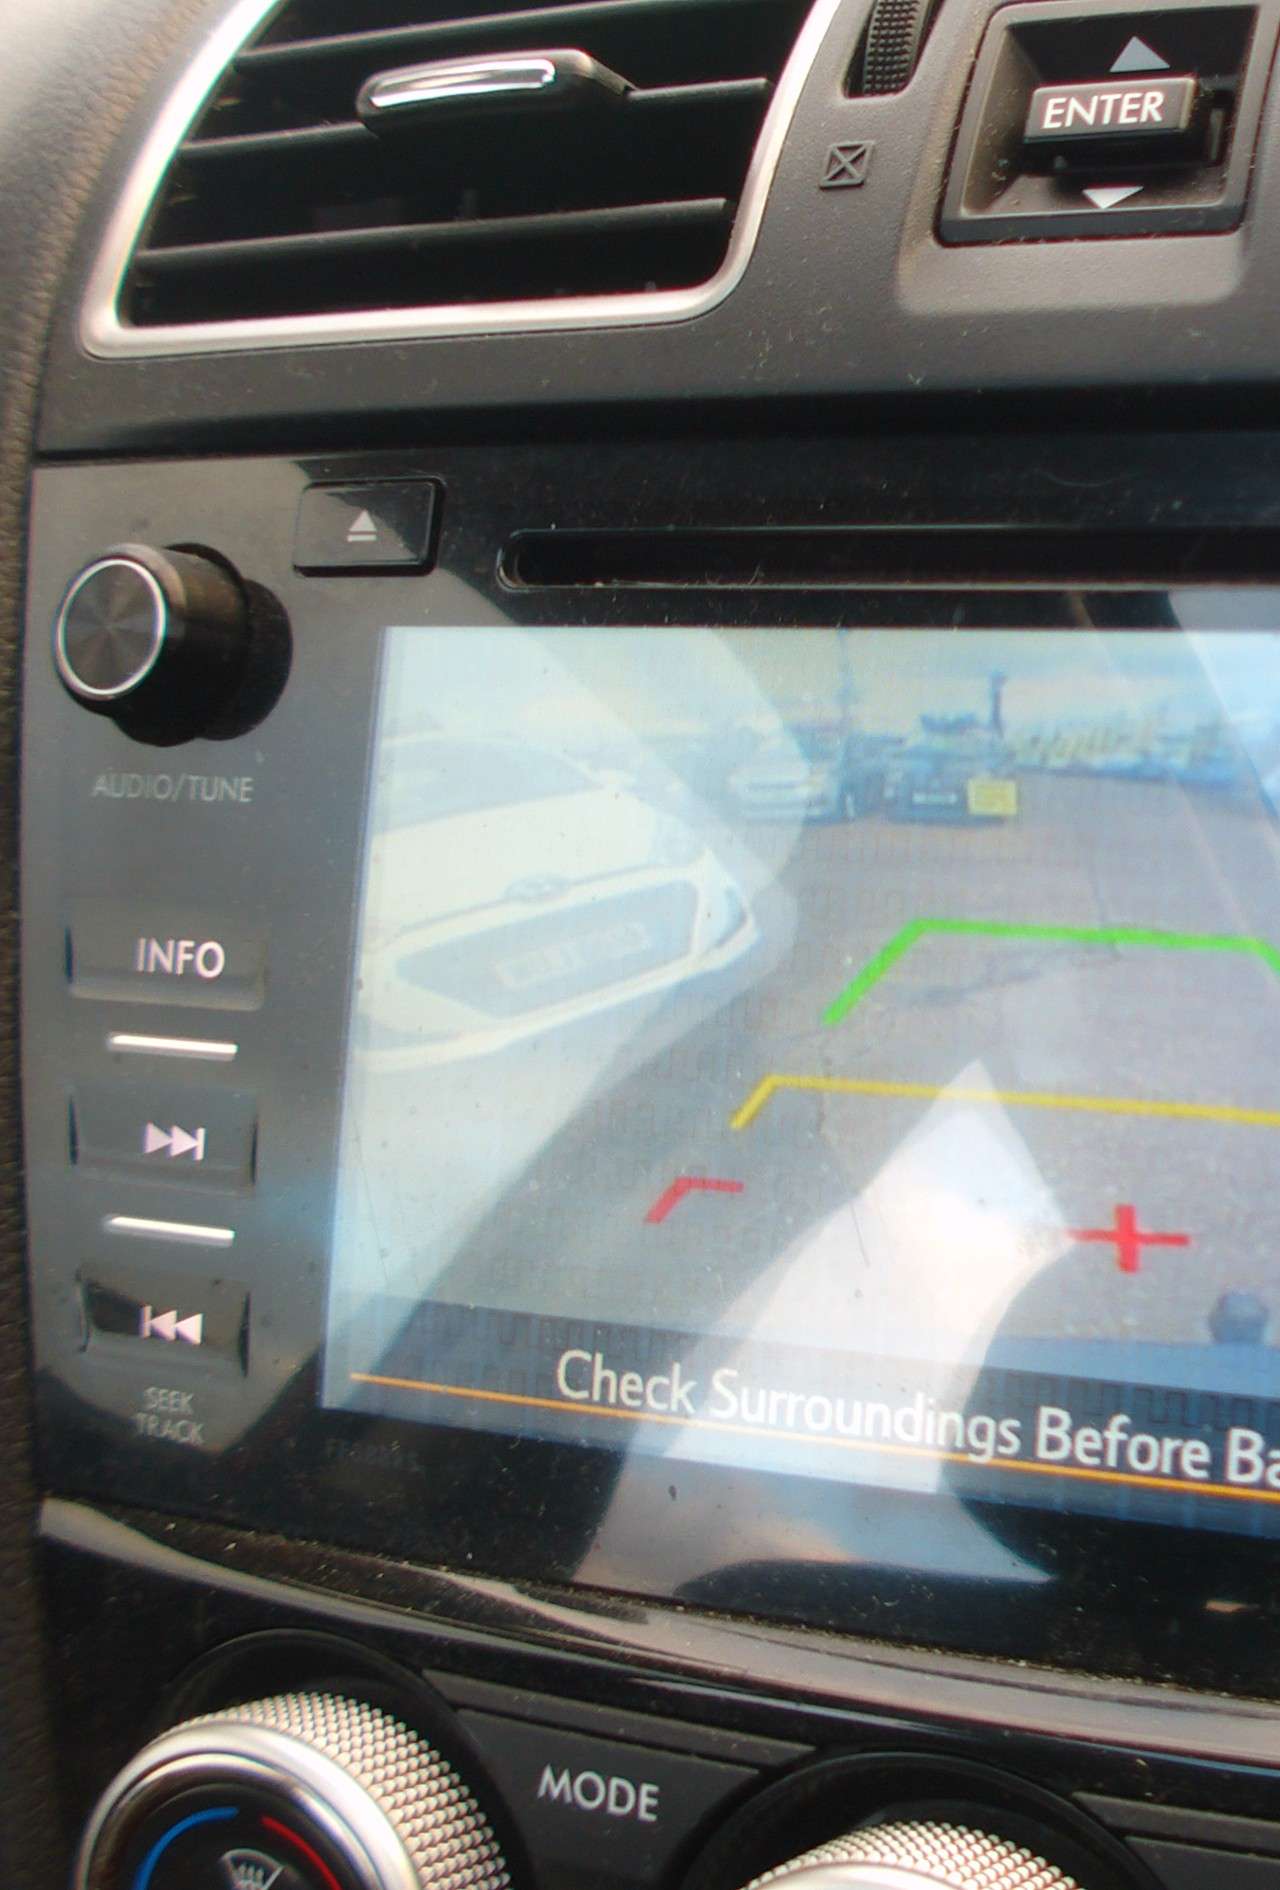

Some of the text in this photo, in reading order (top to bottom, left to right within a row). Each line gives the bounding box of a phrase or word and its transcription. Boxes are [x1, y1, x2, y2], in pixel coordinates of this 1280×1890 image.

[1042, 91, 1165, 129] ENTER
[93, 773, 254, 803] AUDIO/TUNE
[135, 937, 225, 978] INFO
[135, 1411, 205, 1446] TRACK
[555, 1348, 696, 1415] Check
[709, 1367, 1022, 1463] Surroundings
[1034, 1404, 1211, 1479] Before
[537, 1764, 660, 1824] MODE
